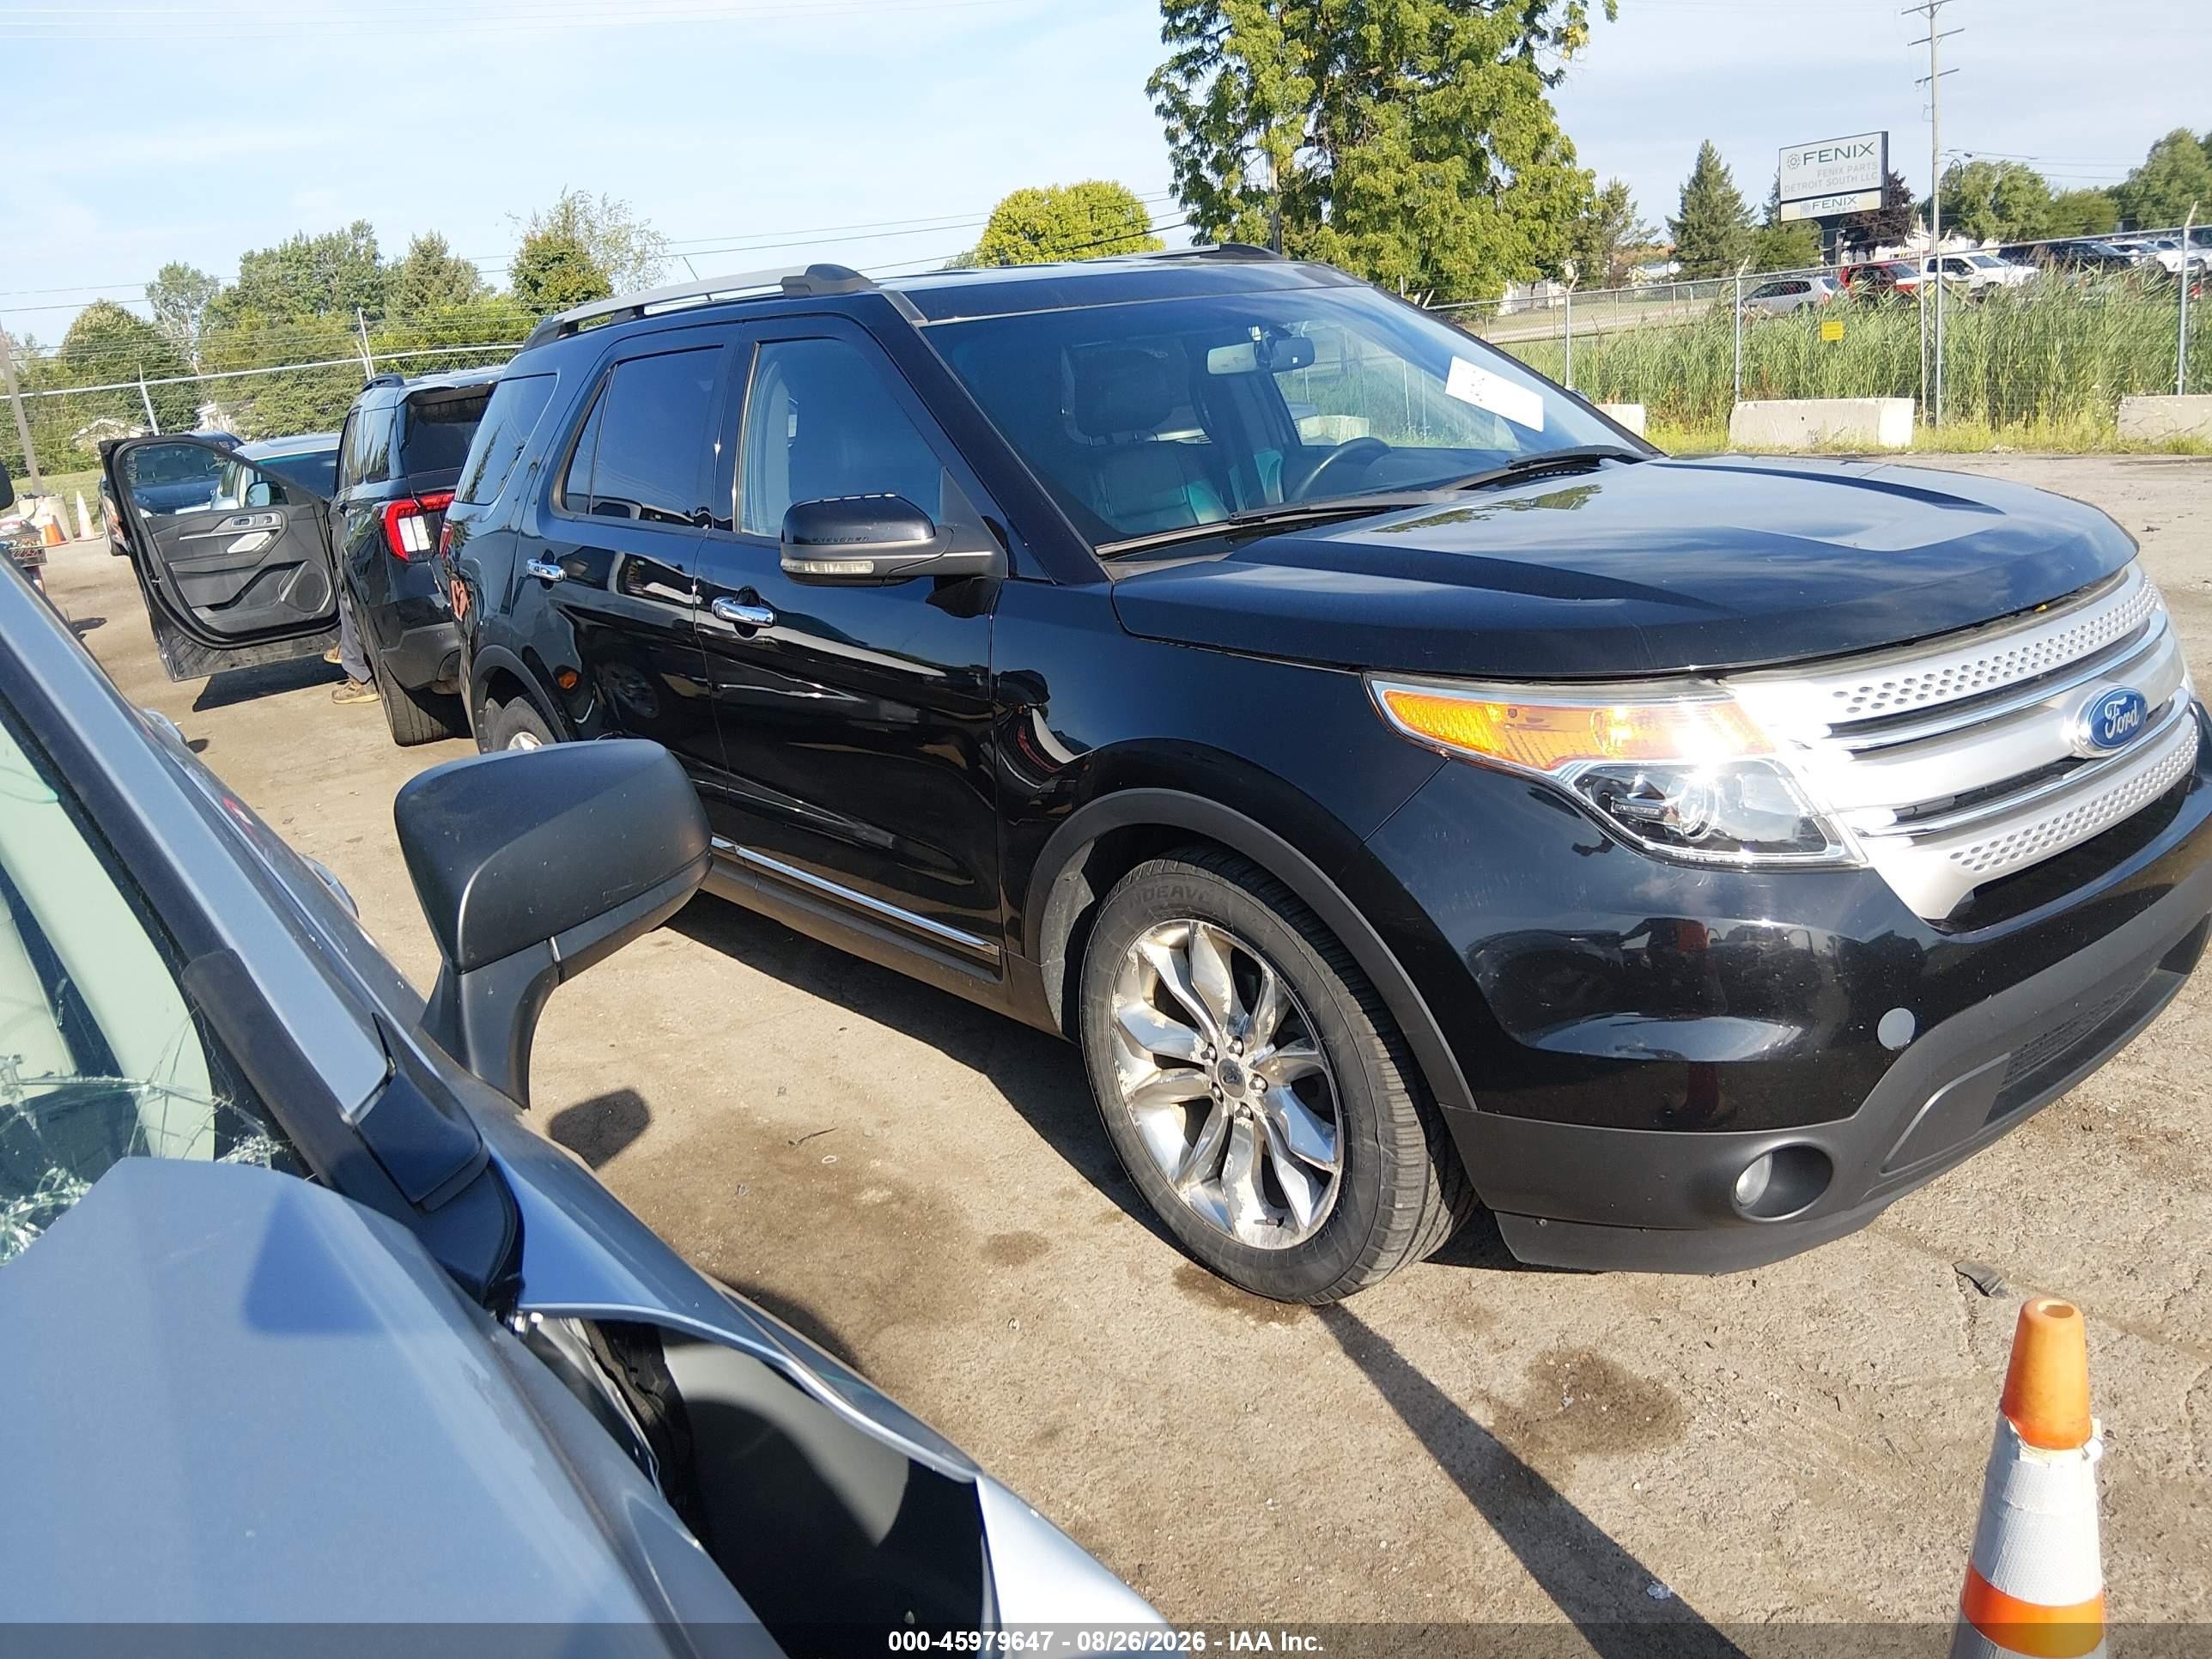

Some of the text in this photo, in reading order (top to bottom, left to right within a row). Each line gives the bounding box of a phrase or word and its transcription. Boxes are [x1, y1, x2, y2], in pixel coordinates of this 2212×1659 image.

[1803, 142, 1875, 165] FENIX
[1817, 161, 1878, 179] FENIX PARTS
[1784, 172, 1878, 193] DETROIT SOUTH LLC
[1812, 196, 1858, 210] FENIX
[2105, 696, 2140, 739] Ford
